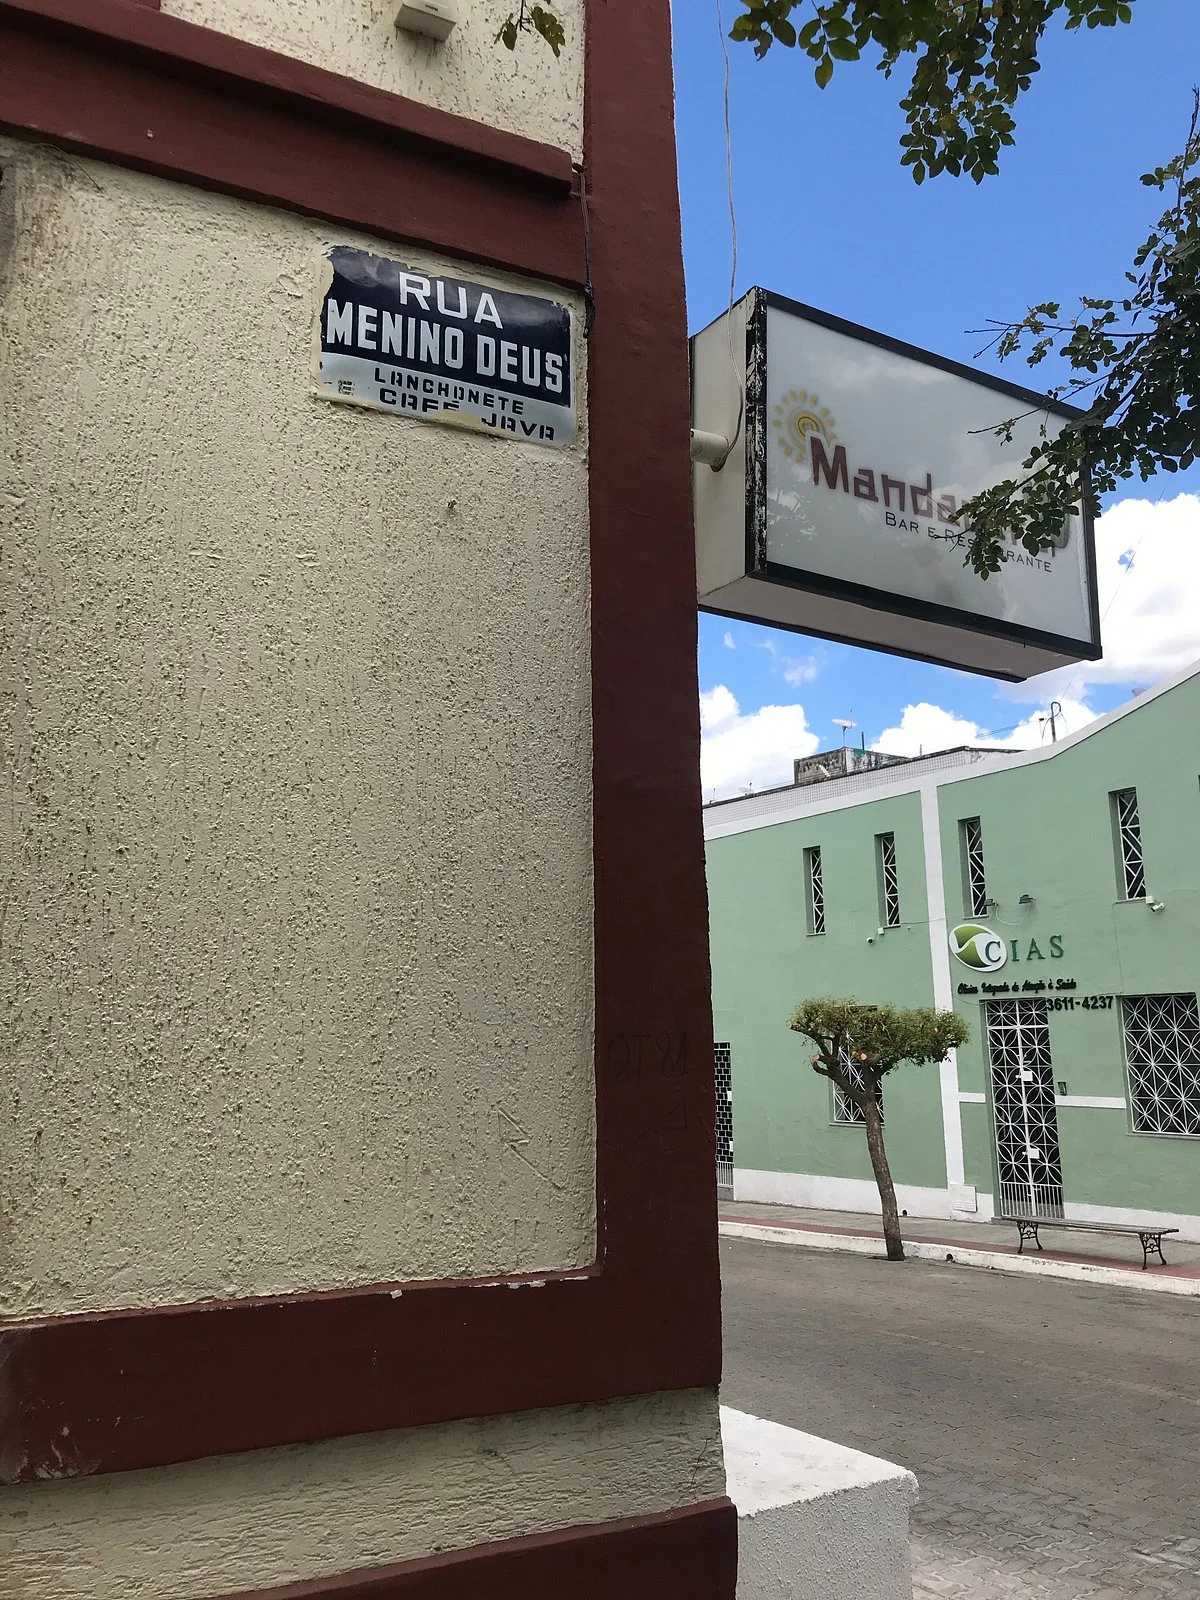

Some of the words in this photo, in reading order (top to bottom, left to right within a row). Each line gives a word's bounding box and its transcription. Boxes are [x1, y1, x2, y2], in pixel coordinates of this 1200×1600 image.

[399, 271, 504, 330] RUA
[326, 298, 464, 370] MENINO
[476, 334, 563, 394] DEUS
[374, 367, 524, 415] LANCHONETE
[481, 413, 555, 441] JAVA
[885, 511, 919, 534] BAR
[928, 526, 938, 540] E
[945, 529, 1052, 573] RESRANTE
[985, 934, 1065, 963] CIAS
[1046, 995, 1114, 1012] 3611-4237
